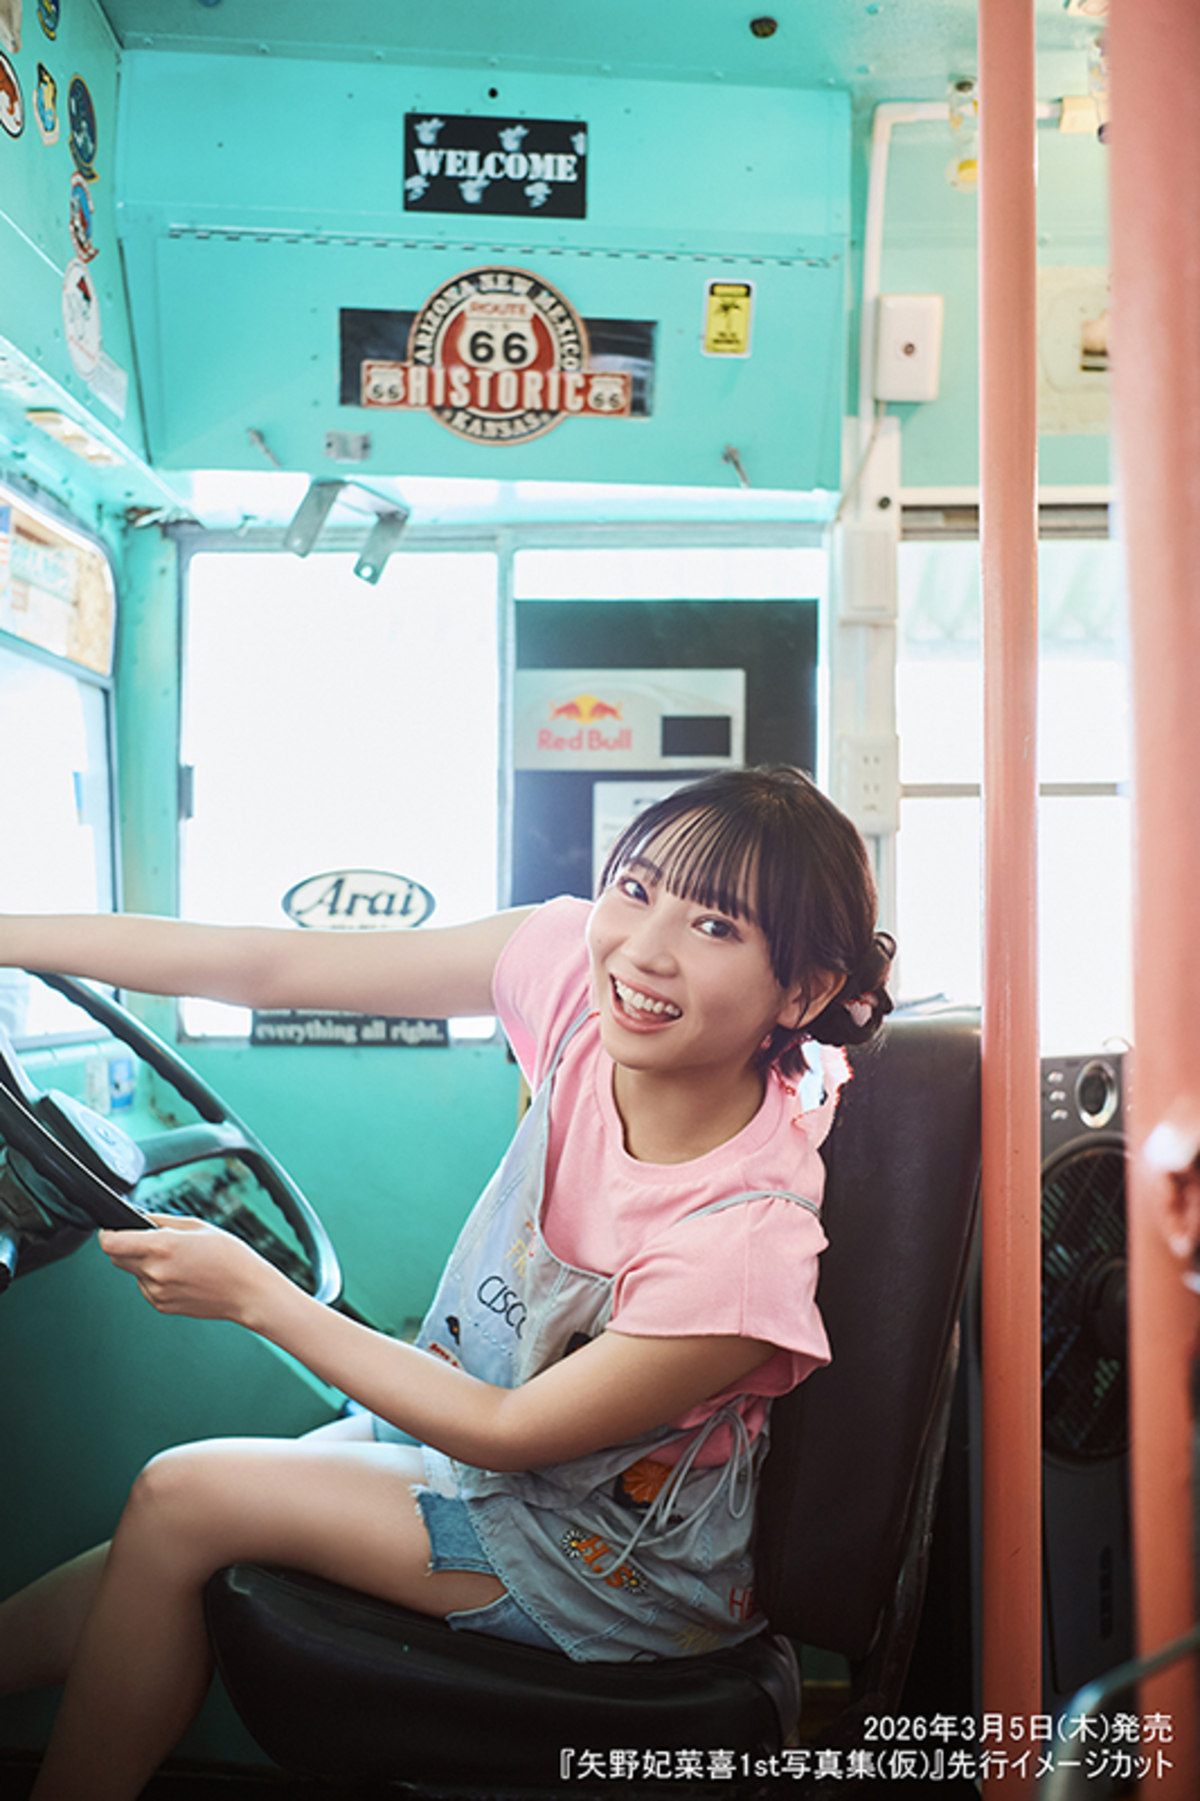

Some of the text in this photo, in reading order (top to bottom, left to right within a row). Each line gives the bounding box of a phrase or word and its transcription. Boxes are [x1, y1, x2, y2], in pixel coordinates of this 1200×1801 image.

[414, 148, 578, 183] WELCOME
[413, 273, 581, 371] ARIZONA NEW MEXICO
[469, 301, 527, 316] ROUTE
[469, 330, 528, 365] 66
[371, 366, 621, 413] 66 HISTORIC 66
[453, 412, 541, 438] KANSAS
[537, 728, 633, 751] Red Bull
[296, 877, 414, 917] Arai
[255, 1020, 445, 1044] everything all right.
